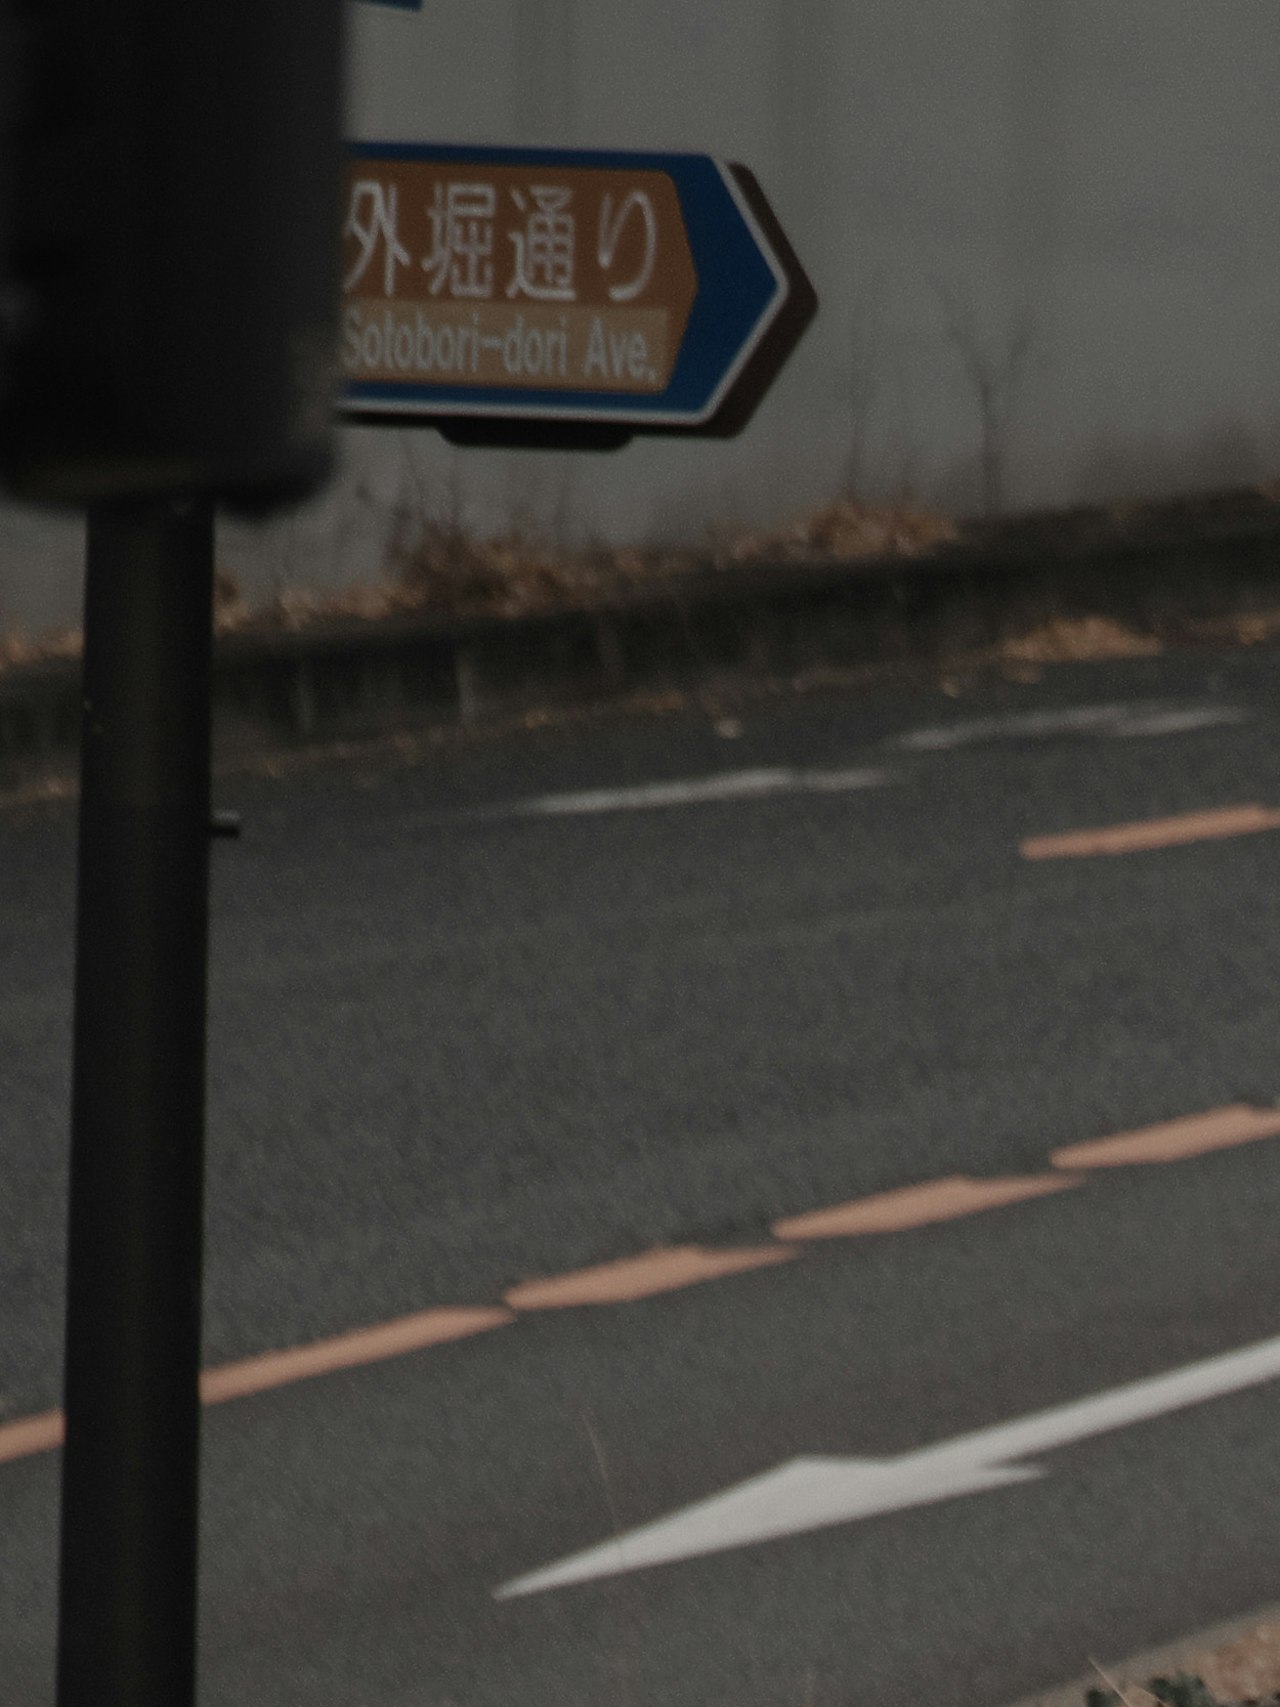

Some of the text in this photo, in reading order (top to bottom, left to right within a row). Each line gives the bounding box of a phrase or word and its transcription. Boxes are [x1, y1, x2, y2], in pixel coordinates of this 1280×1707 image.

[343, 179, 658, 300] 外堀通り
[345, 305, 658, 382] Sotobori-dori Ave.
